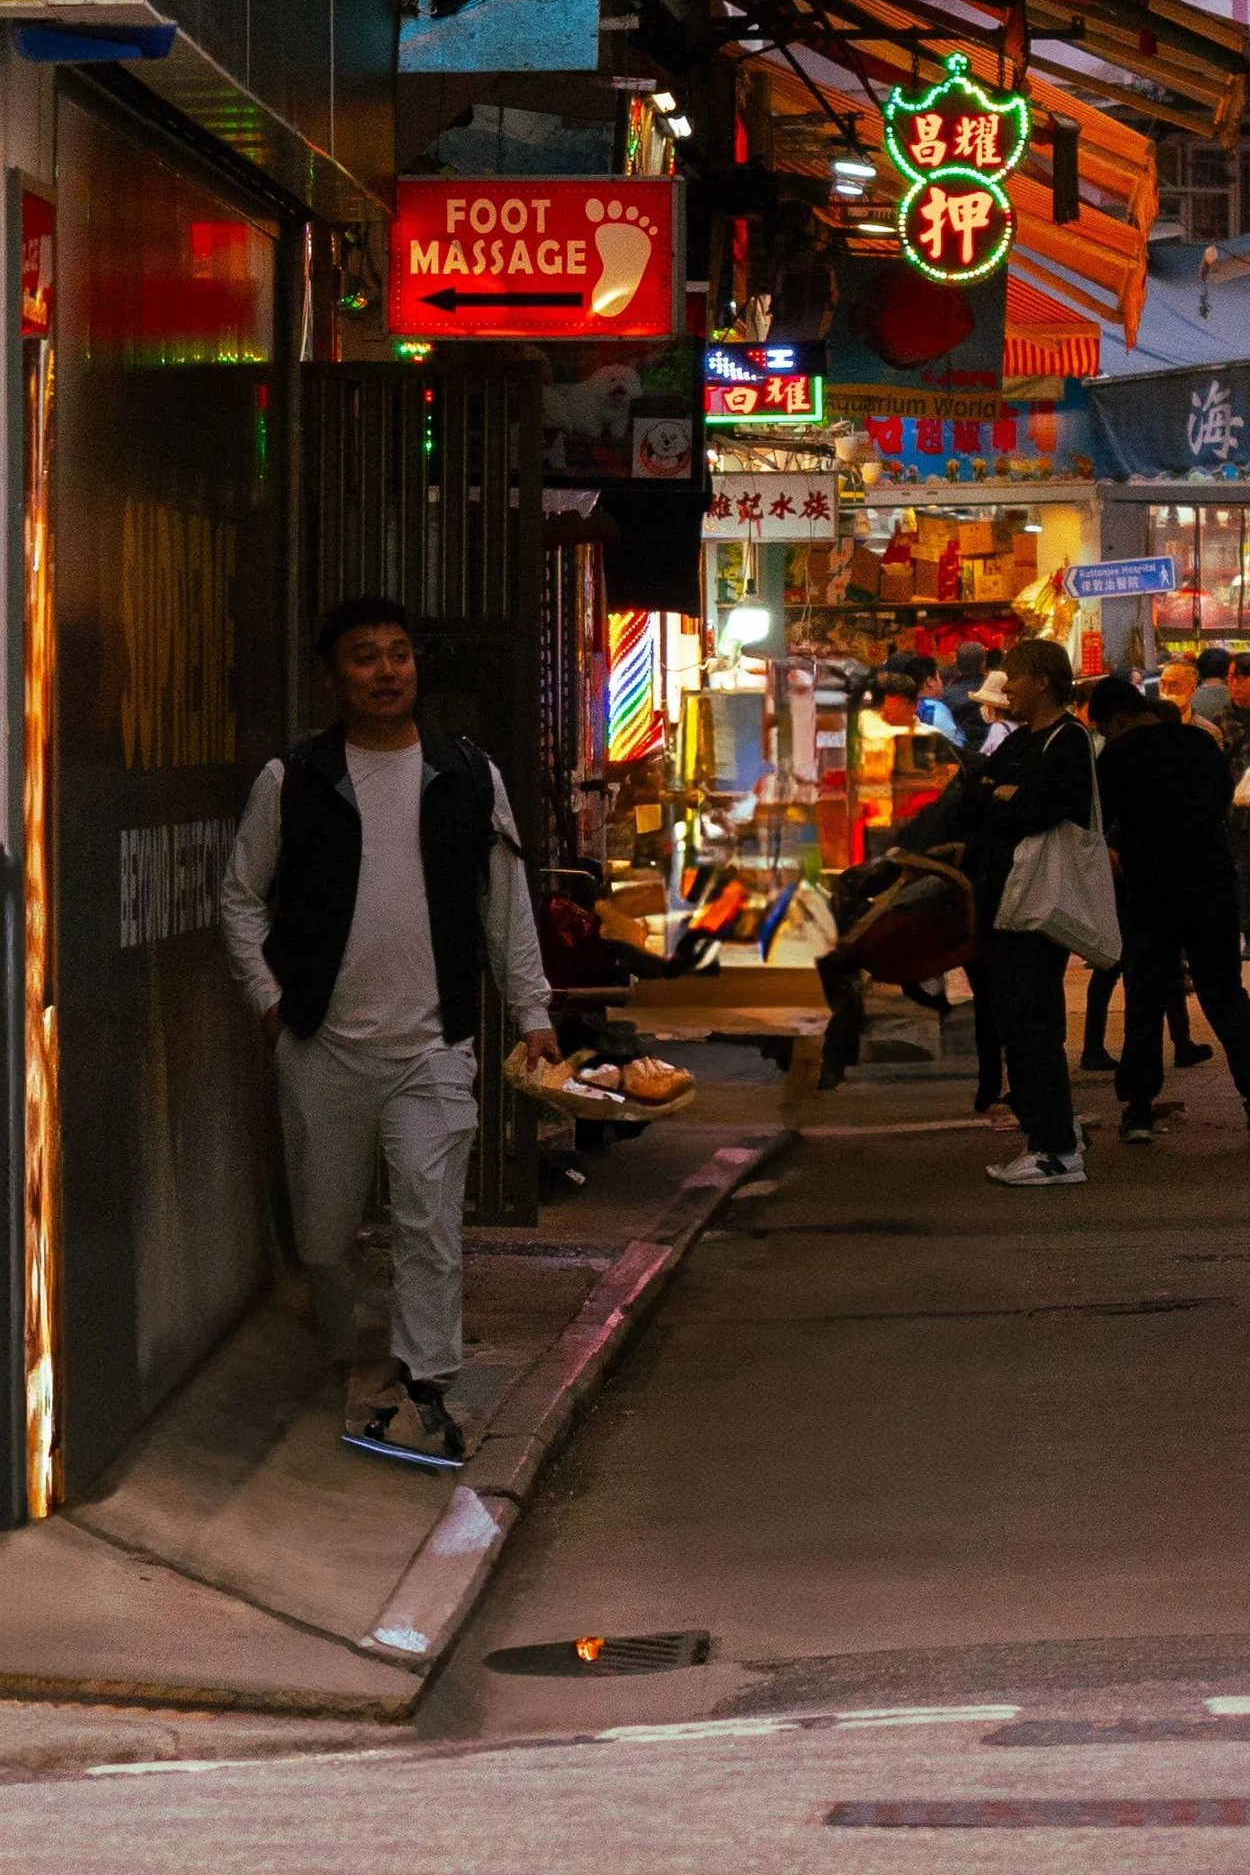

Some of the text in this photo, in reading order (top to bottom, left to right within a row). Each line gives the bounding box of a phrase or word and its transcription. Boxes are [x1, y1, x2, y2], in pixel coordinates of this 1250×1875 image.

[911, 113, 1002, 168] 昌耀
[446, 199, 552, 235] FOOT
[918, 187, 993, 264] 押
[410, 241, 588, 276] MASSAGE
[933, 396, 997, 419] World
